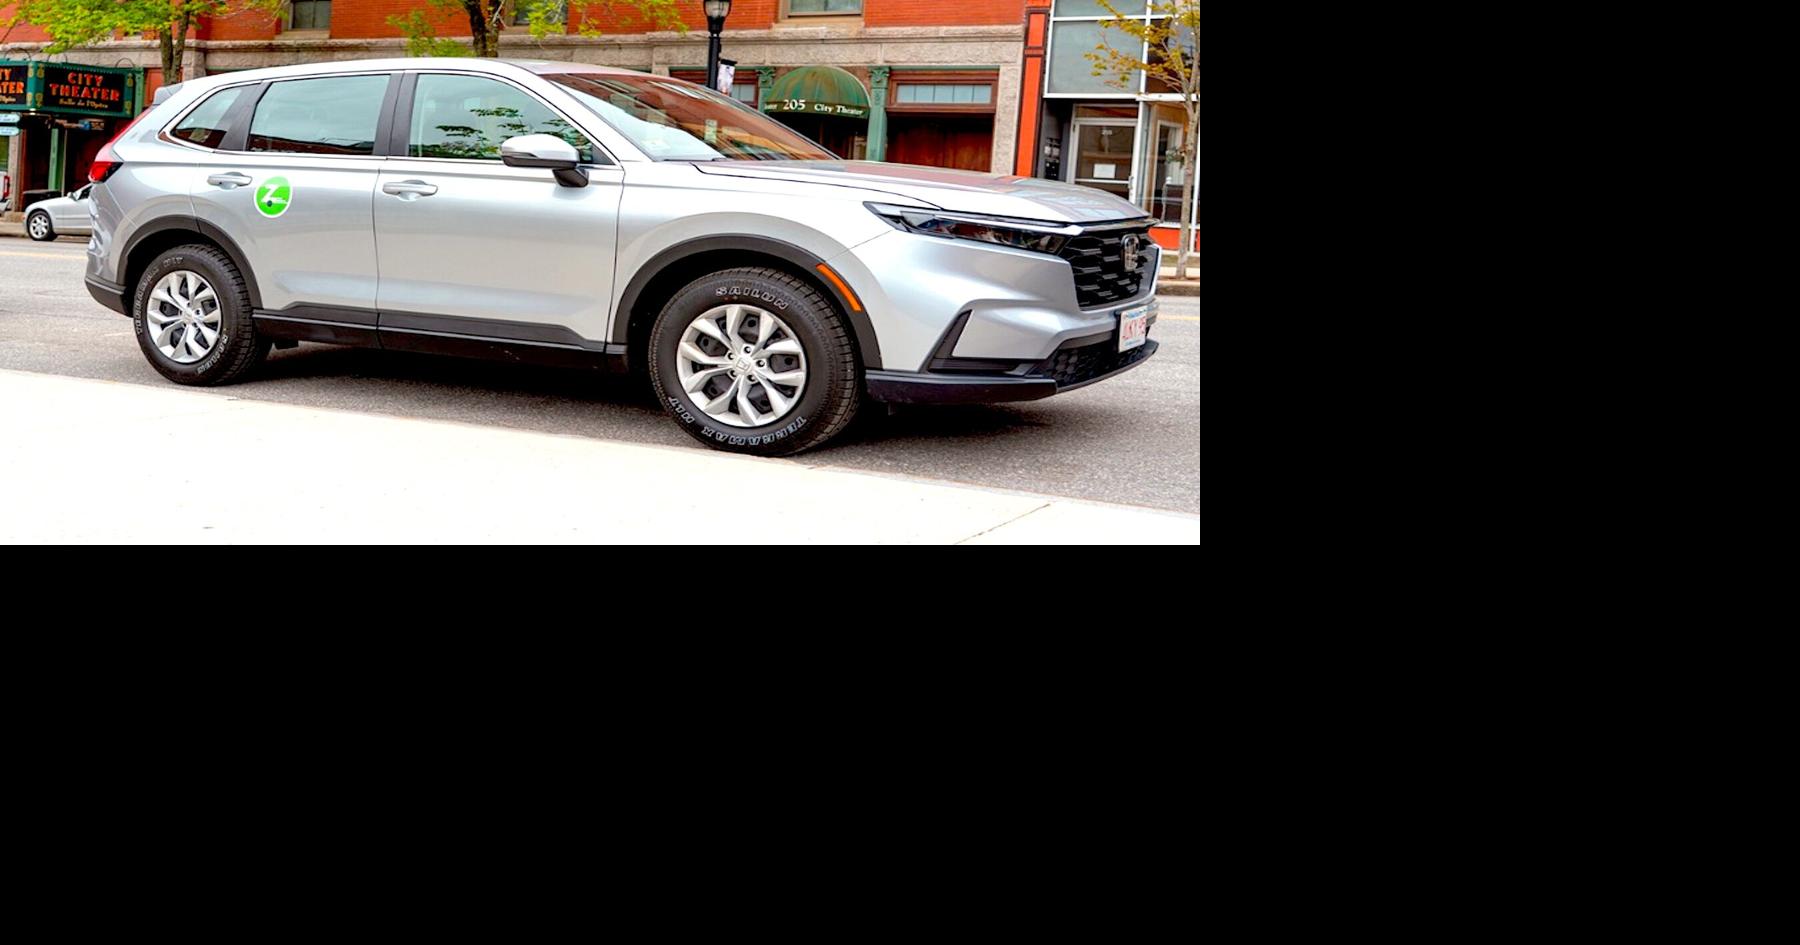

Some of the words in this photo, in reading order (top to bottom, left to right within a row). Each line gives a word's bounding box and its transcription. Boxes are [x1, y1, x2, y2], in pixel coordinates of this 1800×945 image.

[0, 81, 24, 94] TER
[67, 71, 103, 87] CITY
[49, 83, 120, 101] THEATER
[783, 98, 806, 110] 205
[814, 103, 833, 112] City
[836, 104, 863, 115] Theater
[715, 286, 789, 310] SAILUN
